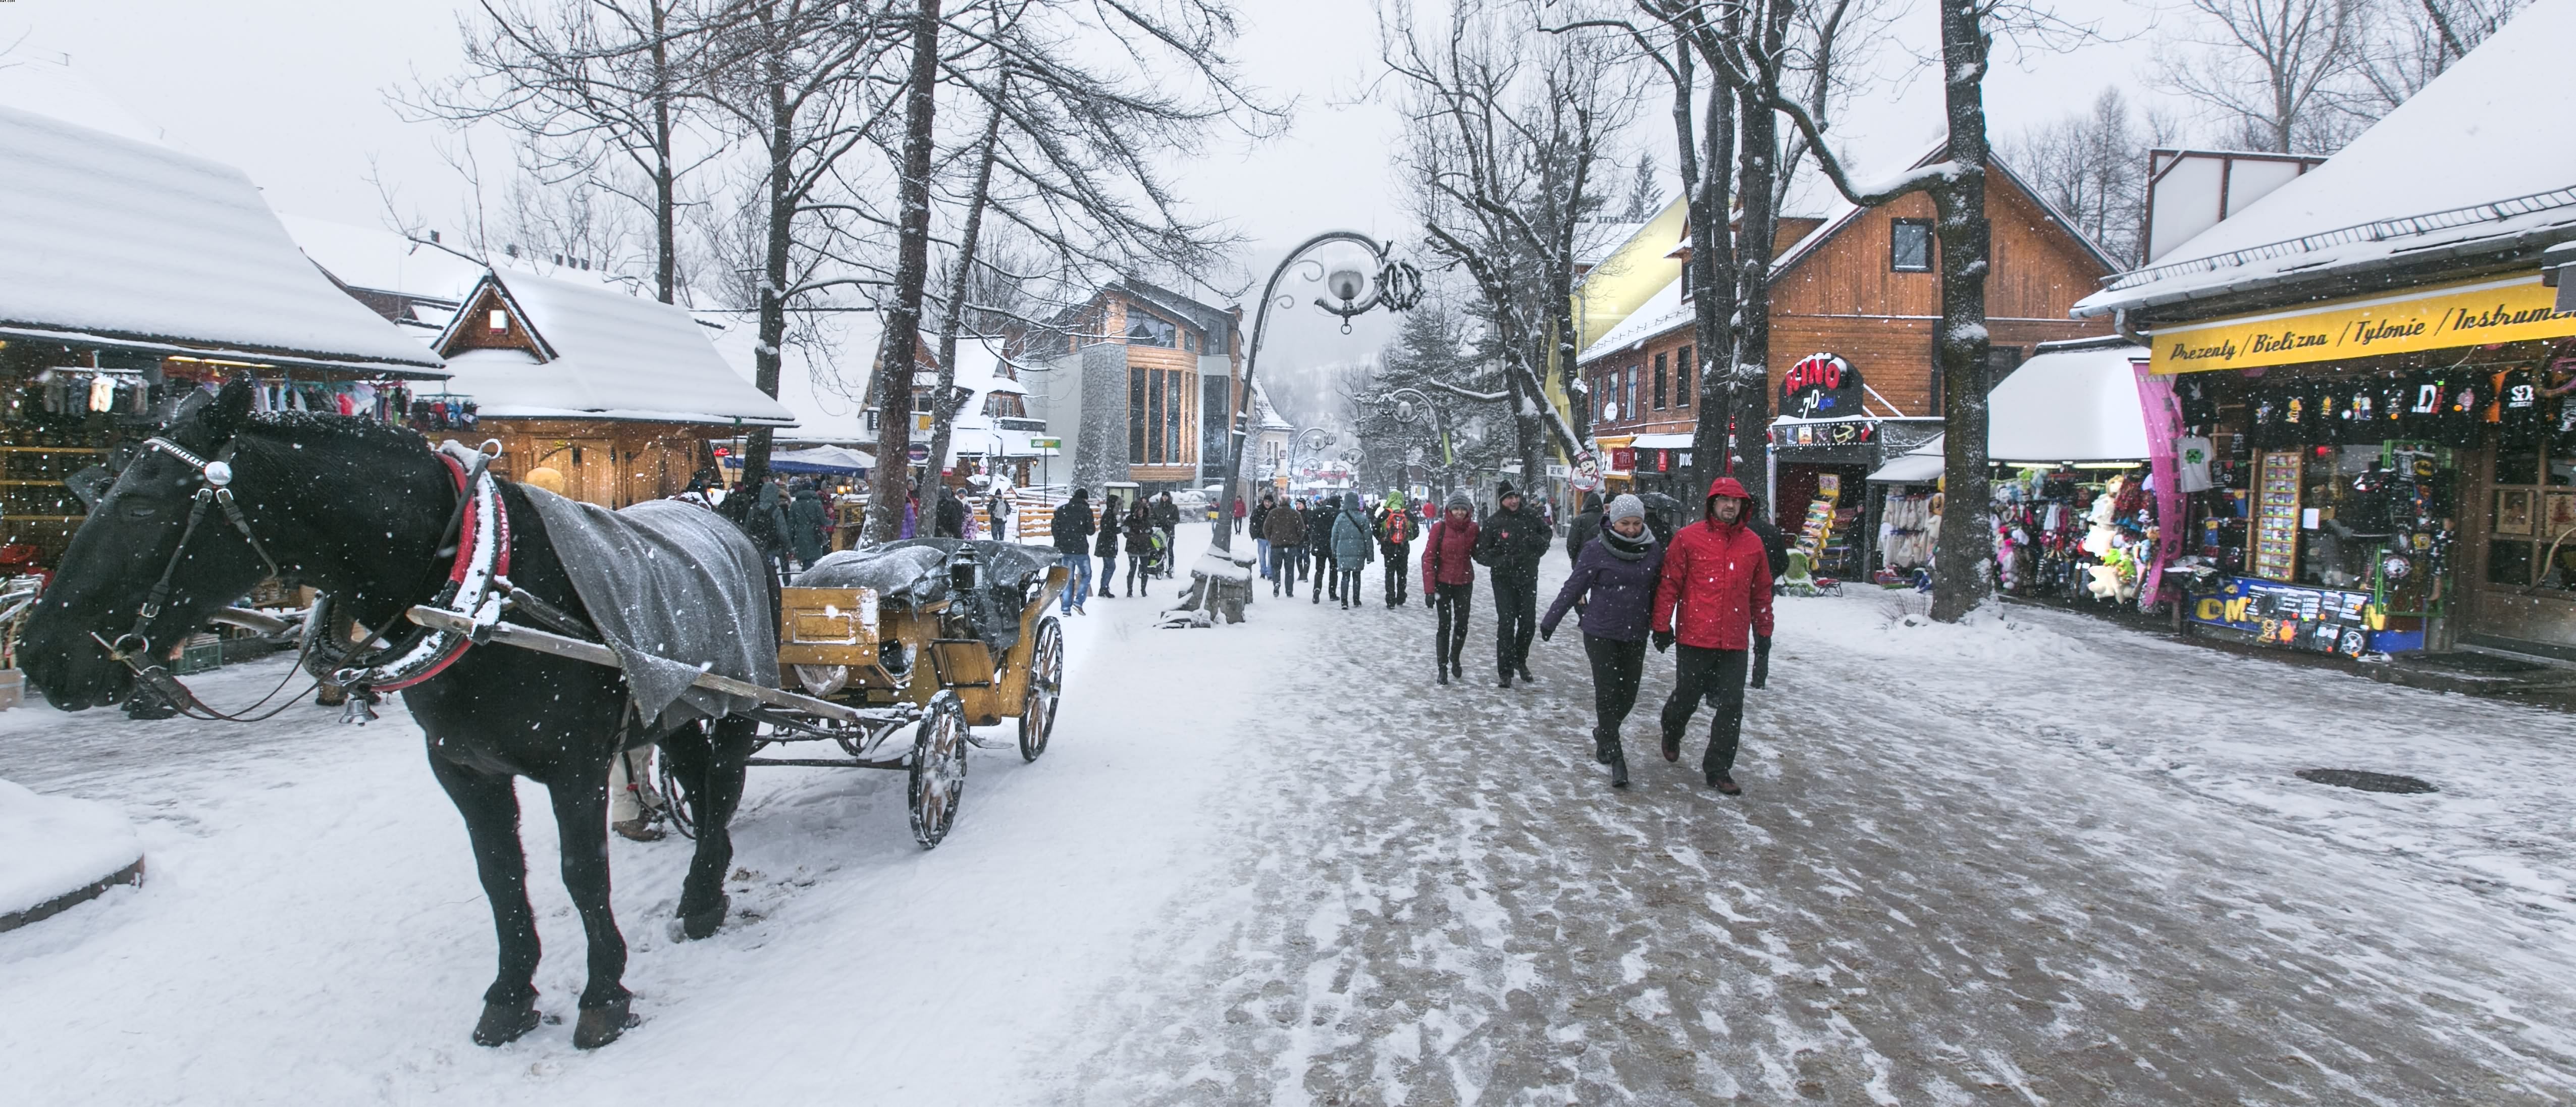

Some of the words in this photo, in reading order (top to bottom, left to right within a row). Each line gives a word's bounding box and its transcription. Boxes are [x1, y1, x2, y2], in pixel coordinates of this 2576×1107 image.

[2170, 339, 2237, 360] Prezenty
[2253, 331, 2329, 353] Bielizna
[2354, 318, 2426, 346] Tytonie
[1785, 359, 1841, 396] KINO
[910, 414, 934, 431] UBWAY
[1679, 451, 1693, 468] proc
